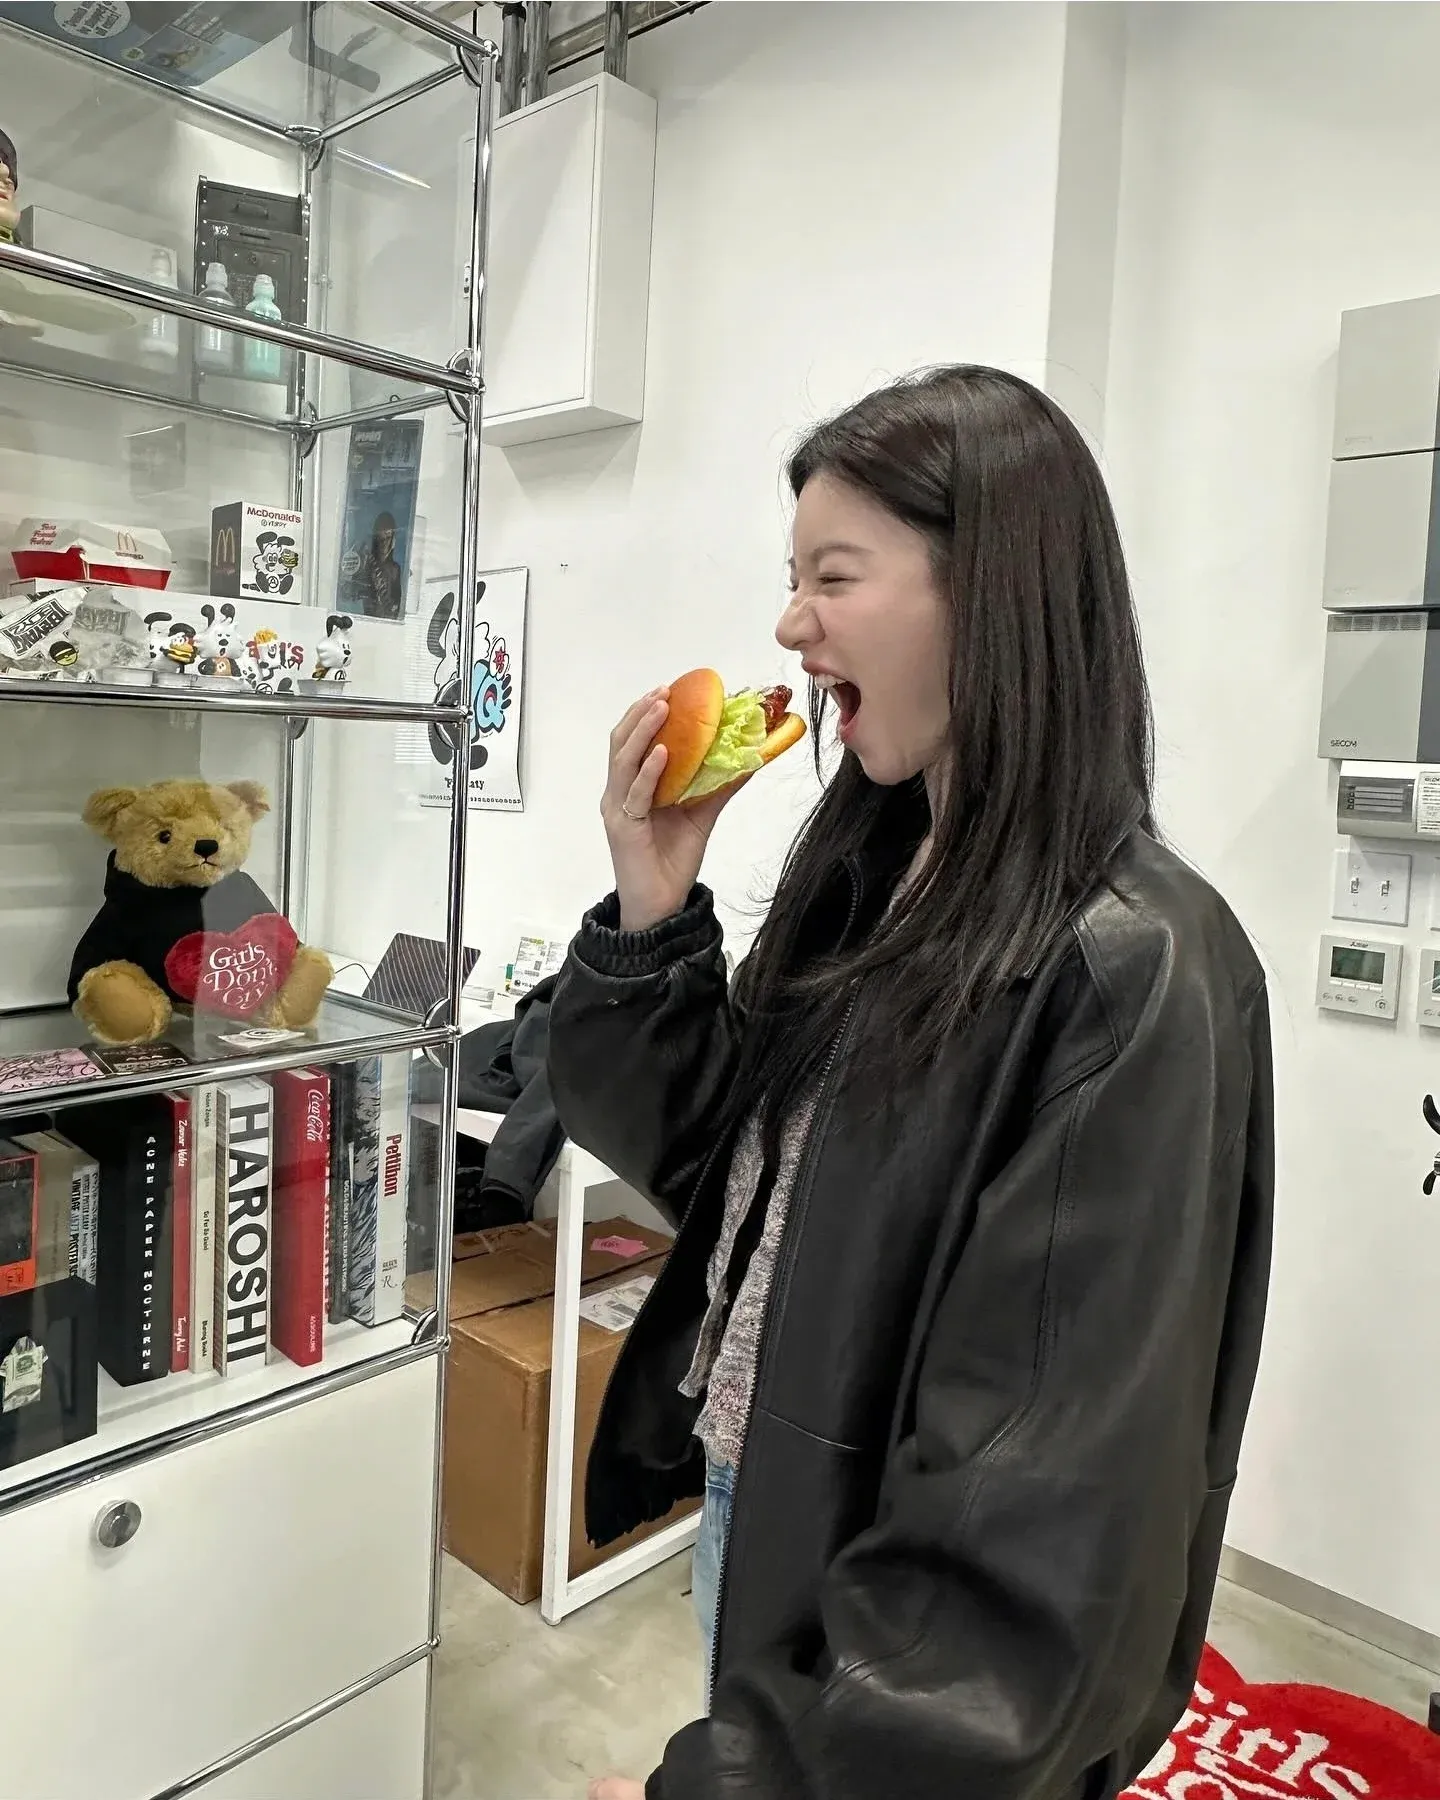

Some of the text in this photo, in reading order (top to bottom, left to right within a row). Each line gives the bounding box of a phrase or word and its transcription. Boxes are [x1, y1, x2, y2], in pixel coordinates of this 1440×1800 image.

[246, 506, 301, 523] McDonald's
[1330, 739, 1357, 748] SECOM
[209, 941, 266, 972] Girls
[222, 981, 269, 1010] Cry
[227, 1101, 270, 1363] HAROSHI
[142, 1136, 156, 1370] ACNE PAPER NOCTURNE
